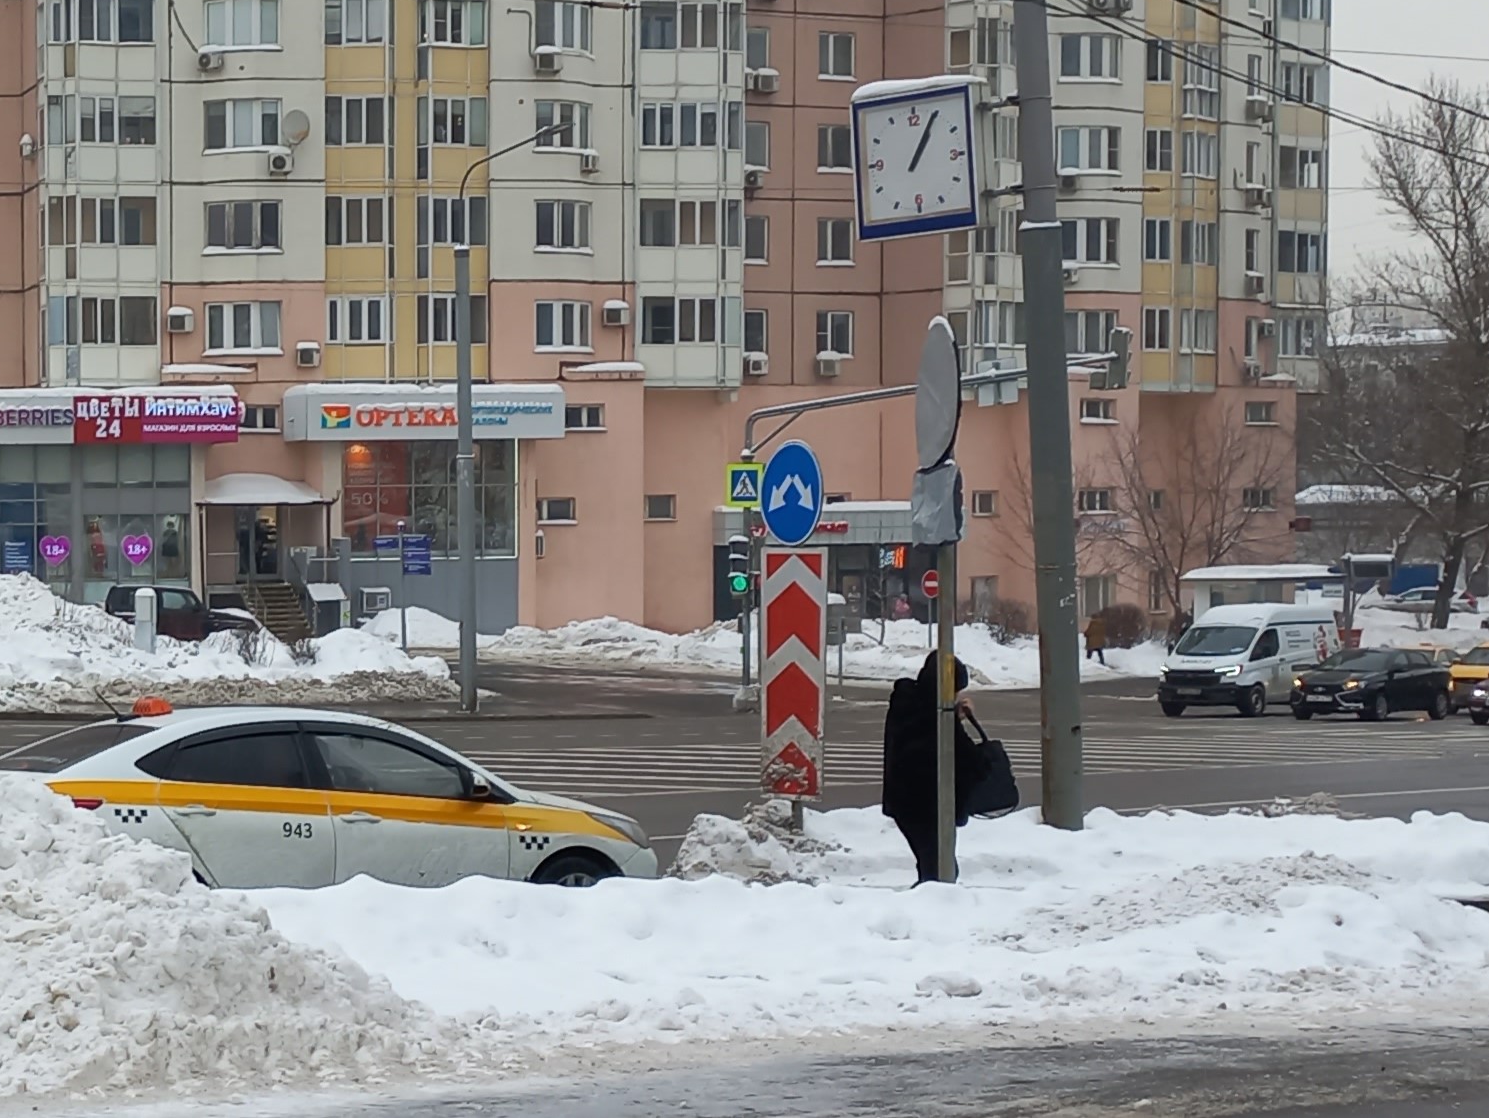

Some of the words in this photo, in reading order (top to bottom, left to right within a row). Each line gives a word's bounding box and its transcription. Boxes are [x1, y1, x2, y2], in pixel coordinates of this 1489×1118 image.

[907, 115, 920, 126] 12
[950, 149, 959, 161] 3
[875, 159, 884, 171] 9
[915, 194, 923, 205] 6
[76, 398, 139, 422] ЦВЕТЫ
[95, 419, 121, 438] 24
[179, 425, 196, 433] ДЛЯ
[127, 544, 148, 556] 18+
[283, 822, 312, 839] 943
